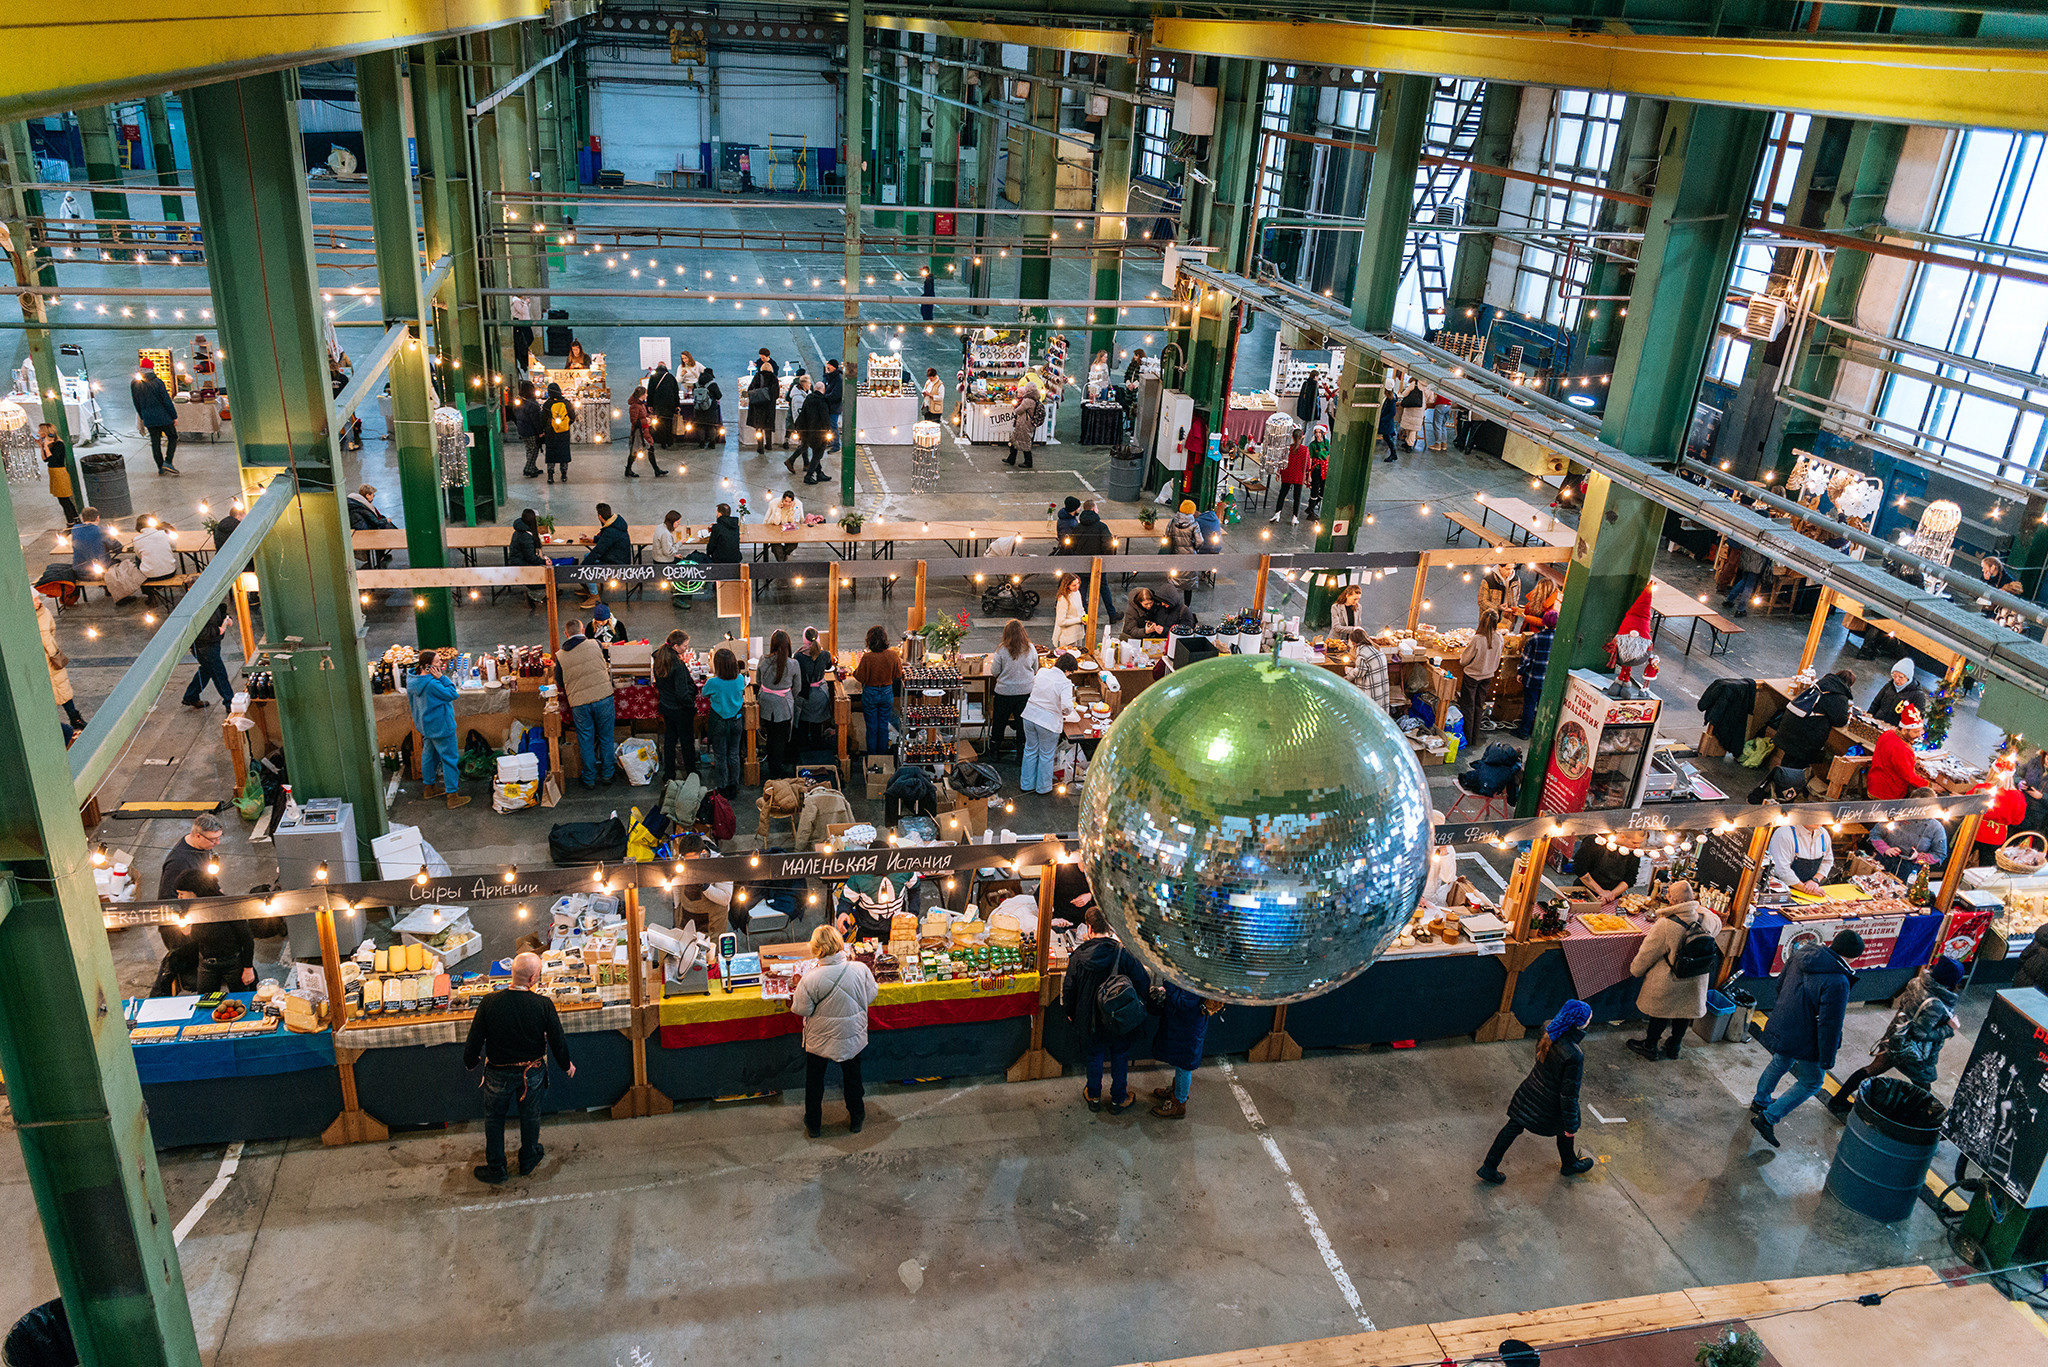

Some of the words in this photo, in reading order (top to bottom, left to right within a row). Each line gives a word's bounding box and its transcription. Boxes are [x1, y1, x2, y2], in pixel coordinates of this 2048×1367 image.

[1563, 697, 1600, 730] КОЛБАСНИК
[1574, 694, 1592, 712] ГНОМ
[781, 854, 879, 876] МАЛЕНЬКАЯ
